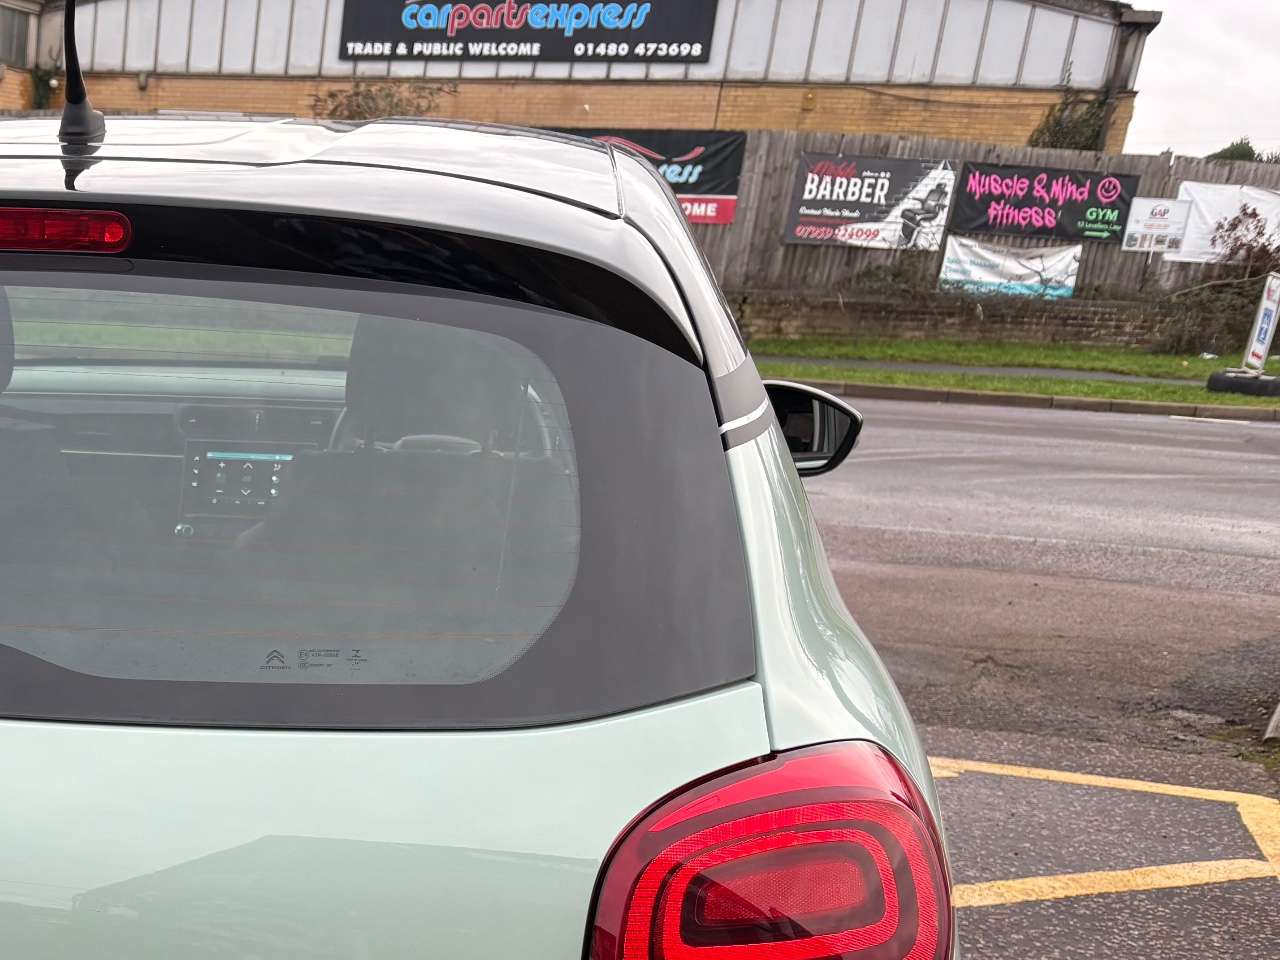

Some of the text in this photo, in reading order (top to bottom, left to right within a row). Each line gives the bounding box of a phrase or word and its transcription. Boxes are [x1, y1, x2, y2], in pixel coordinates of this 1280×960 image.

[401, 1, 652, 38] carpartsexpress
[346, 42, 703, 57] TRADE & PUBLIC WELCOME 01480 473698
[802, 172, 890, 205] BARBER
[966, 170, 1091, 206] Muscle & Mind
[1086, 207, 1119, 222] GYM
